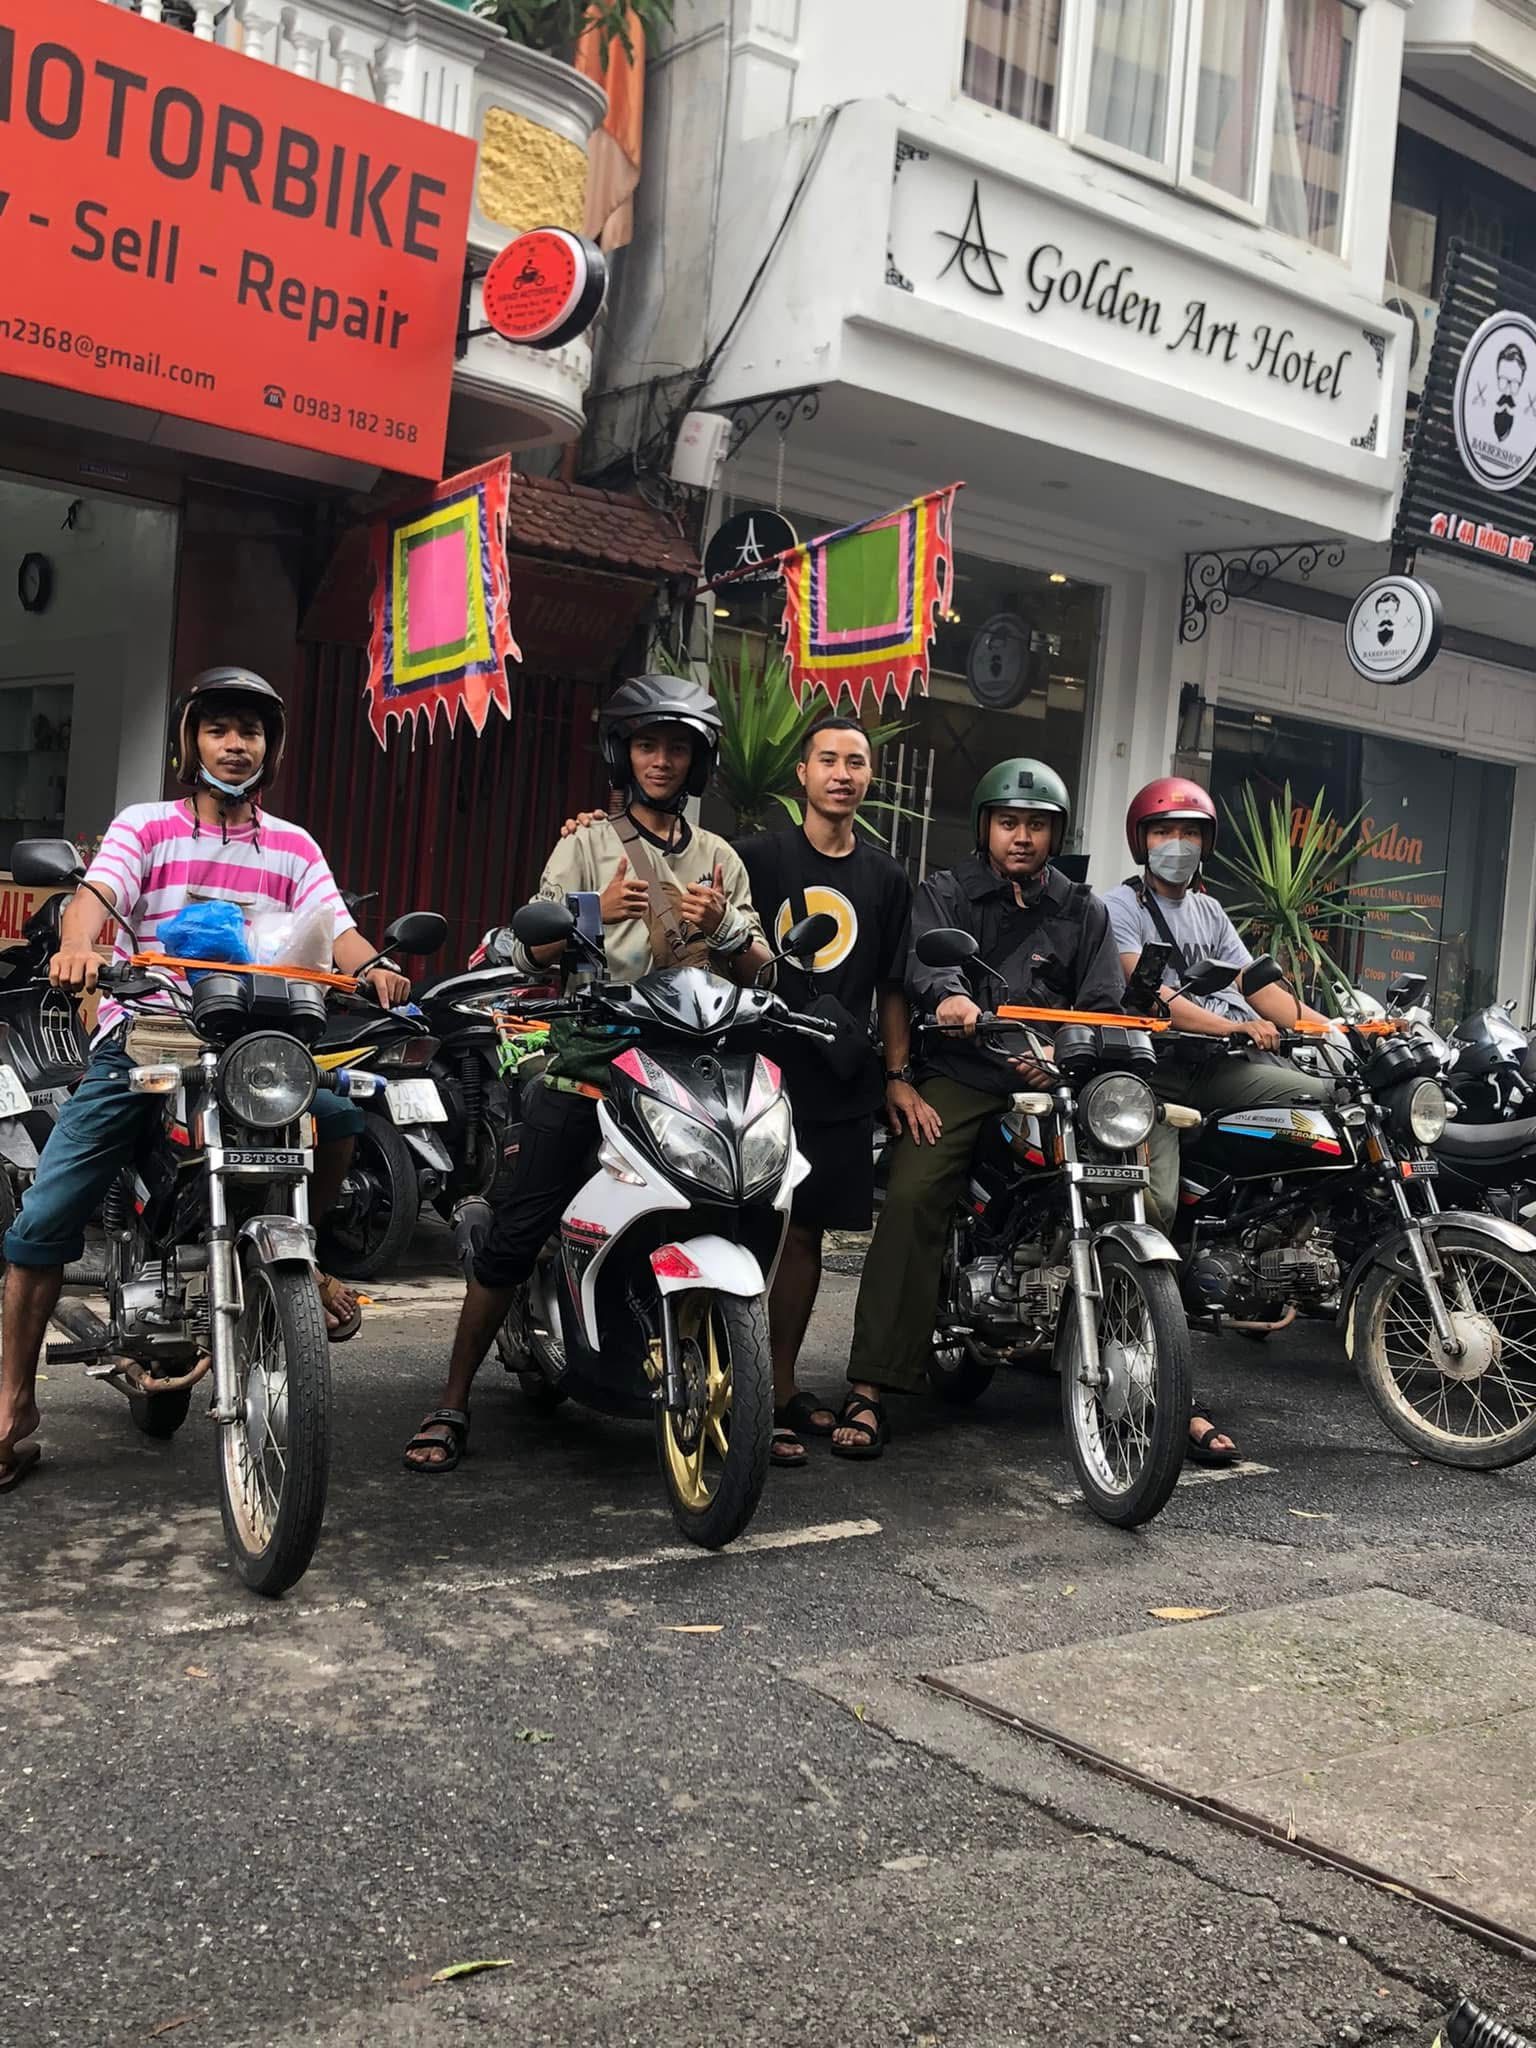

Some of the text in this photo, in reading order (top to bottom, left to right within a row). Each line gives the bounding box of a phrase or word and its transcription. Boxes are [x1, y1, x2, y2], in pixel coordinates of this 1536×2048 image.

[71, 199, 179, 284] Sell
[237, 249, 408, 349] Repair
[1027, 244, 1352, 400] Golden Art Hotel
[293, 394, 418, 443] 0983 182 368
[229, 1153, 299, 1164] DETECH
[1087, 1167, 1140, 1179] DETECH
